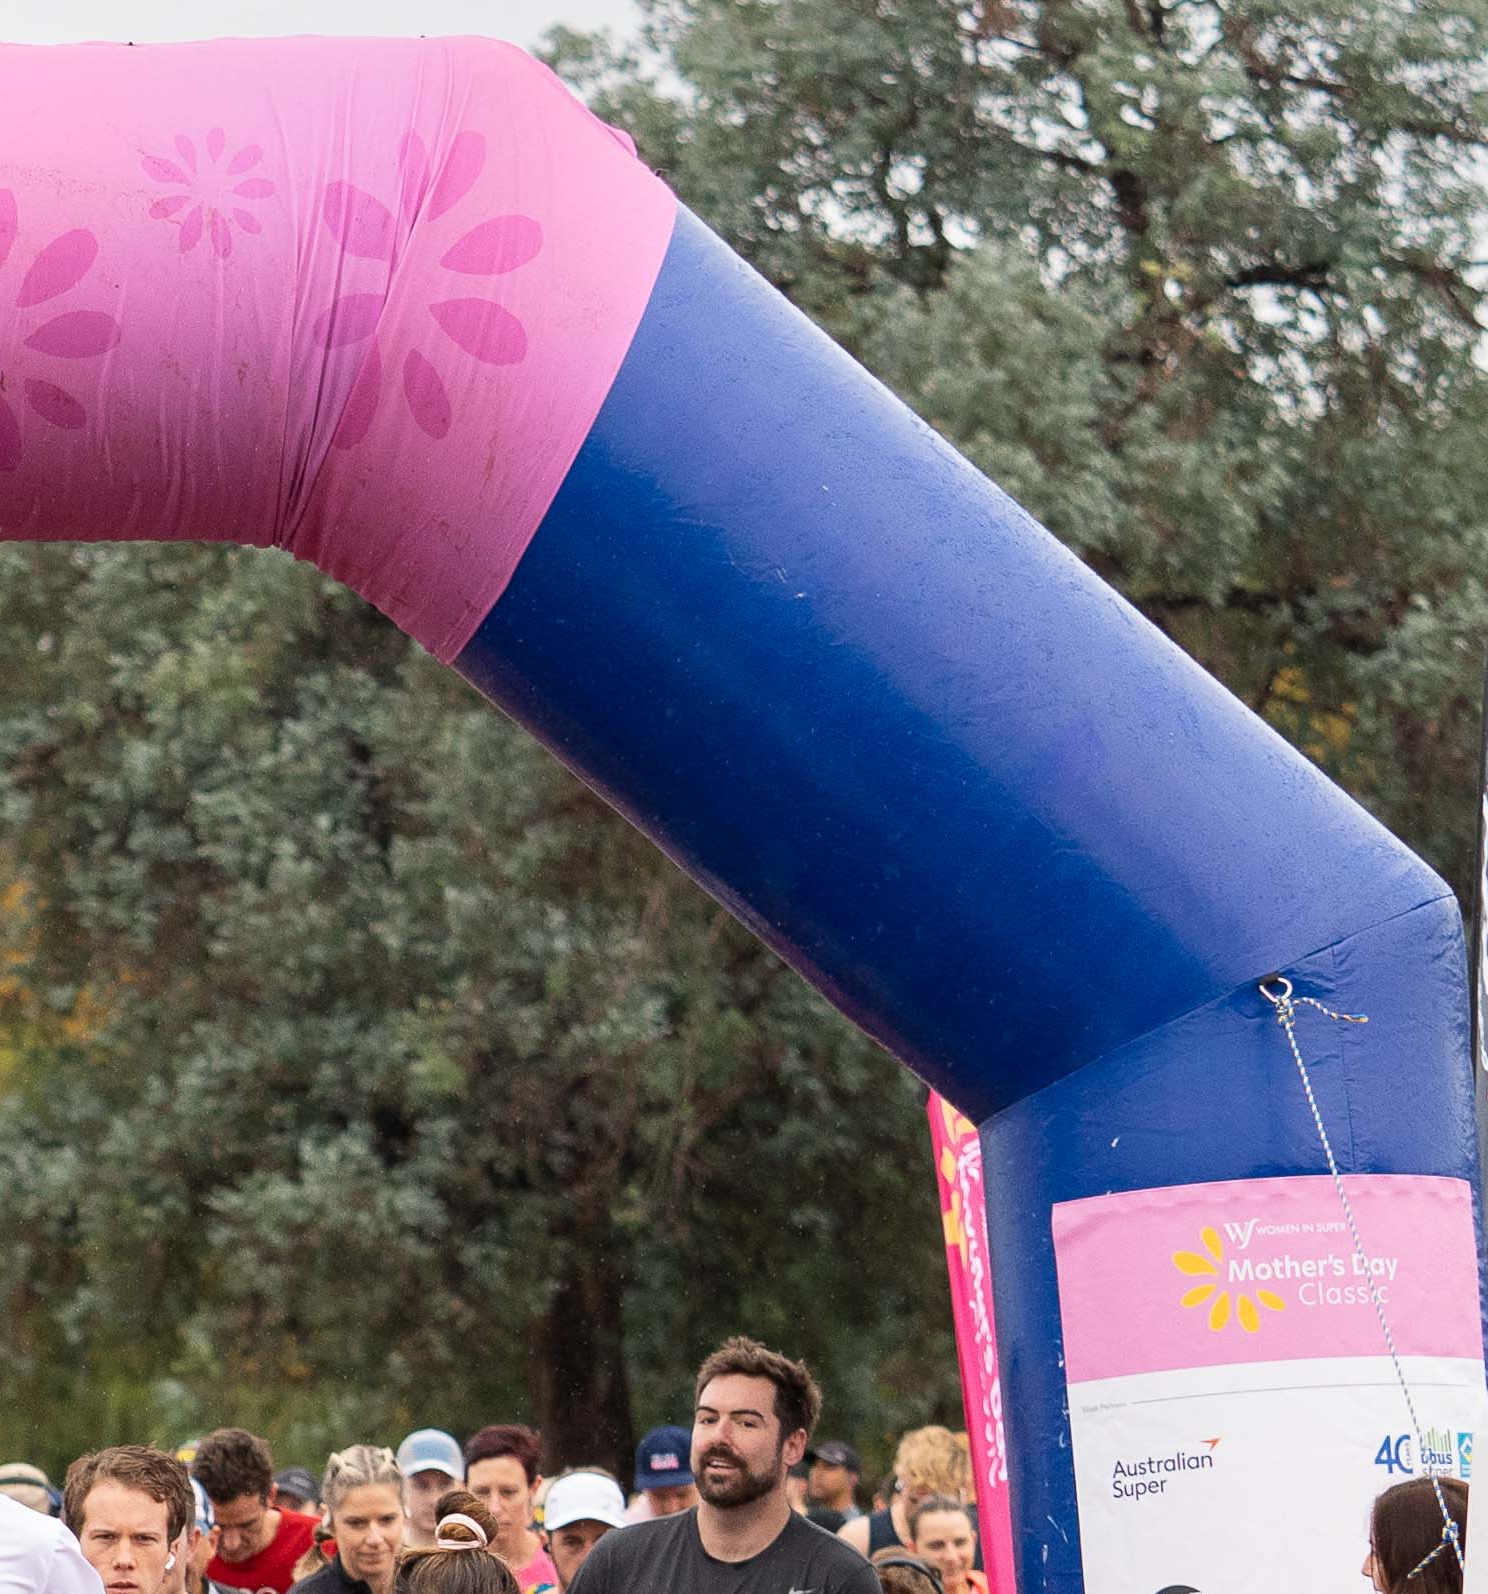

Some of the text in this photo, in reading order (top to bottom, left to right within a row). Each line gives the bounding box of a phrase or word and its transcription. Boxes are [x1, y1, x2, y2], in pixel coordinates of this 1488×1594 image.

[1256, 1222, 1346, 1236] WOMEN IN SUPER
[1351, 1252, 1399, 1281] Day
[1113, 1452, 1213, 1479] Australian
[1113, 1479, 1166, 1501] Super
